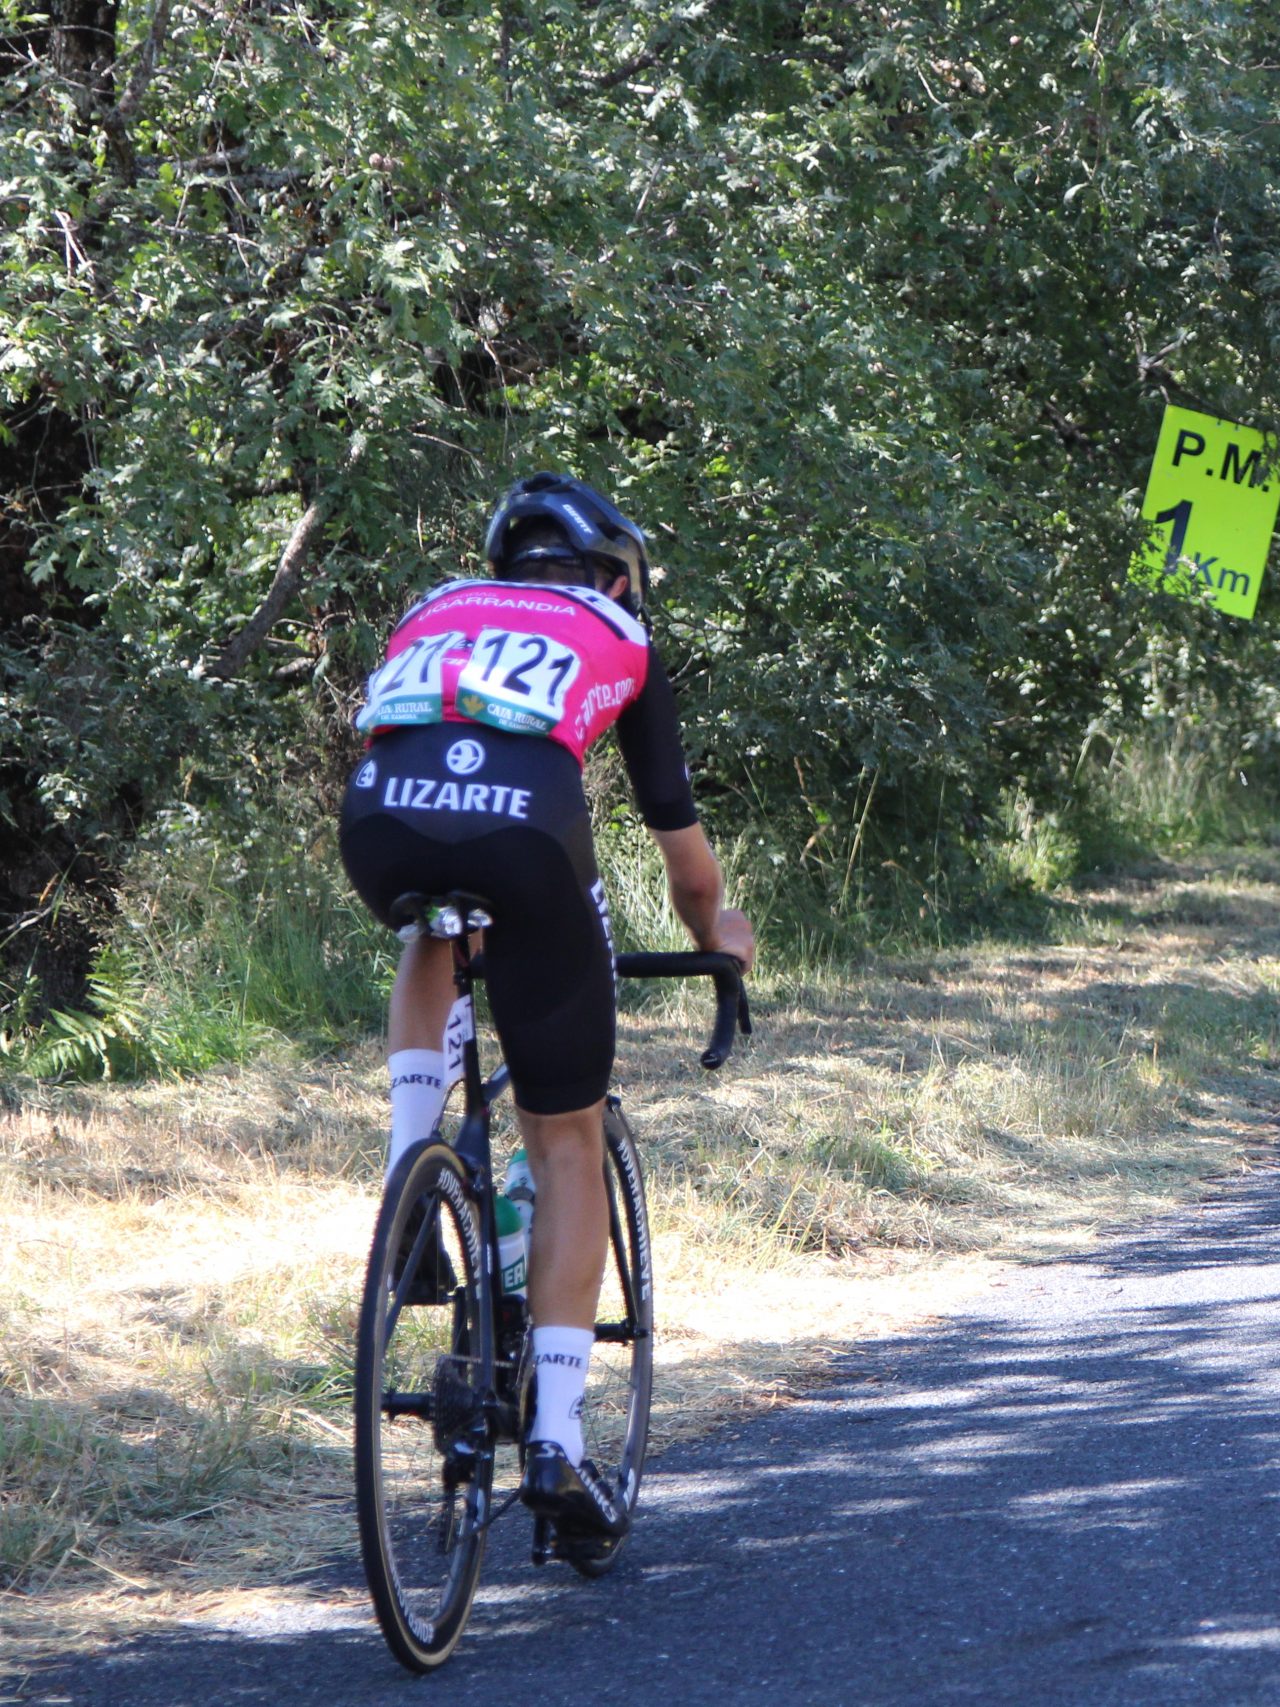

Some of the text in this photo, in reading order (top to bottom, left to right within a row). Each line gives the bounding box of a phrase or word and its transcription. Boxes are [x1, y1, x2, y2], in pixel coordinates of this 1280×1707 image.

[1172, 429, 1270, 492] P.M.
[1155, 499, 1250, 596] 1 Km
[372, 632, 456, 696] 21
[481, 632, 575, 706] 121
[394, 701, 432, 714] RURAL
[487, 702, 549, 731] CAJA RURAL
[383, 776, 532, 820] LIZARTE
[447, 1014, 463, 1070] 121
